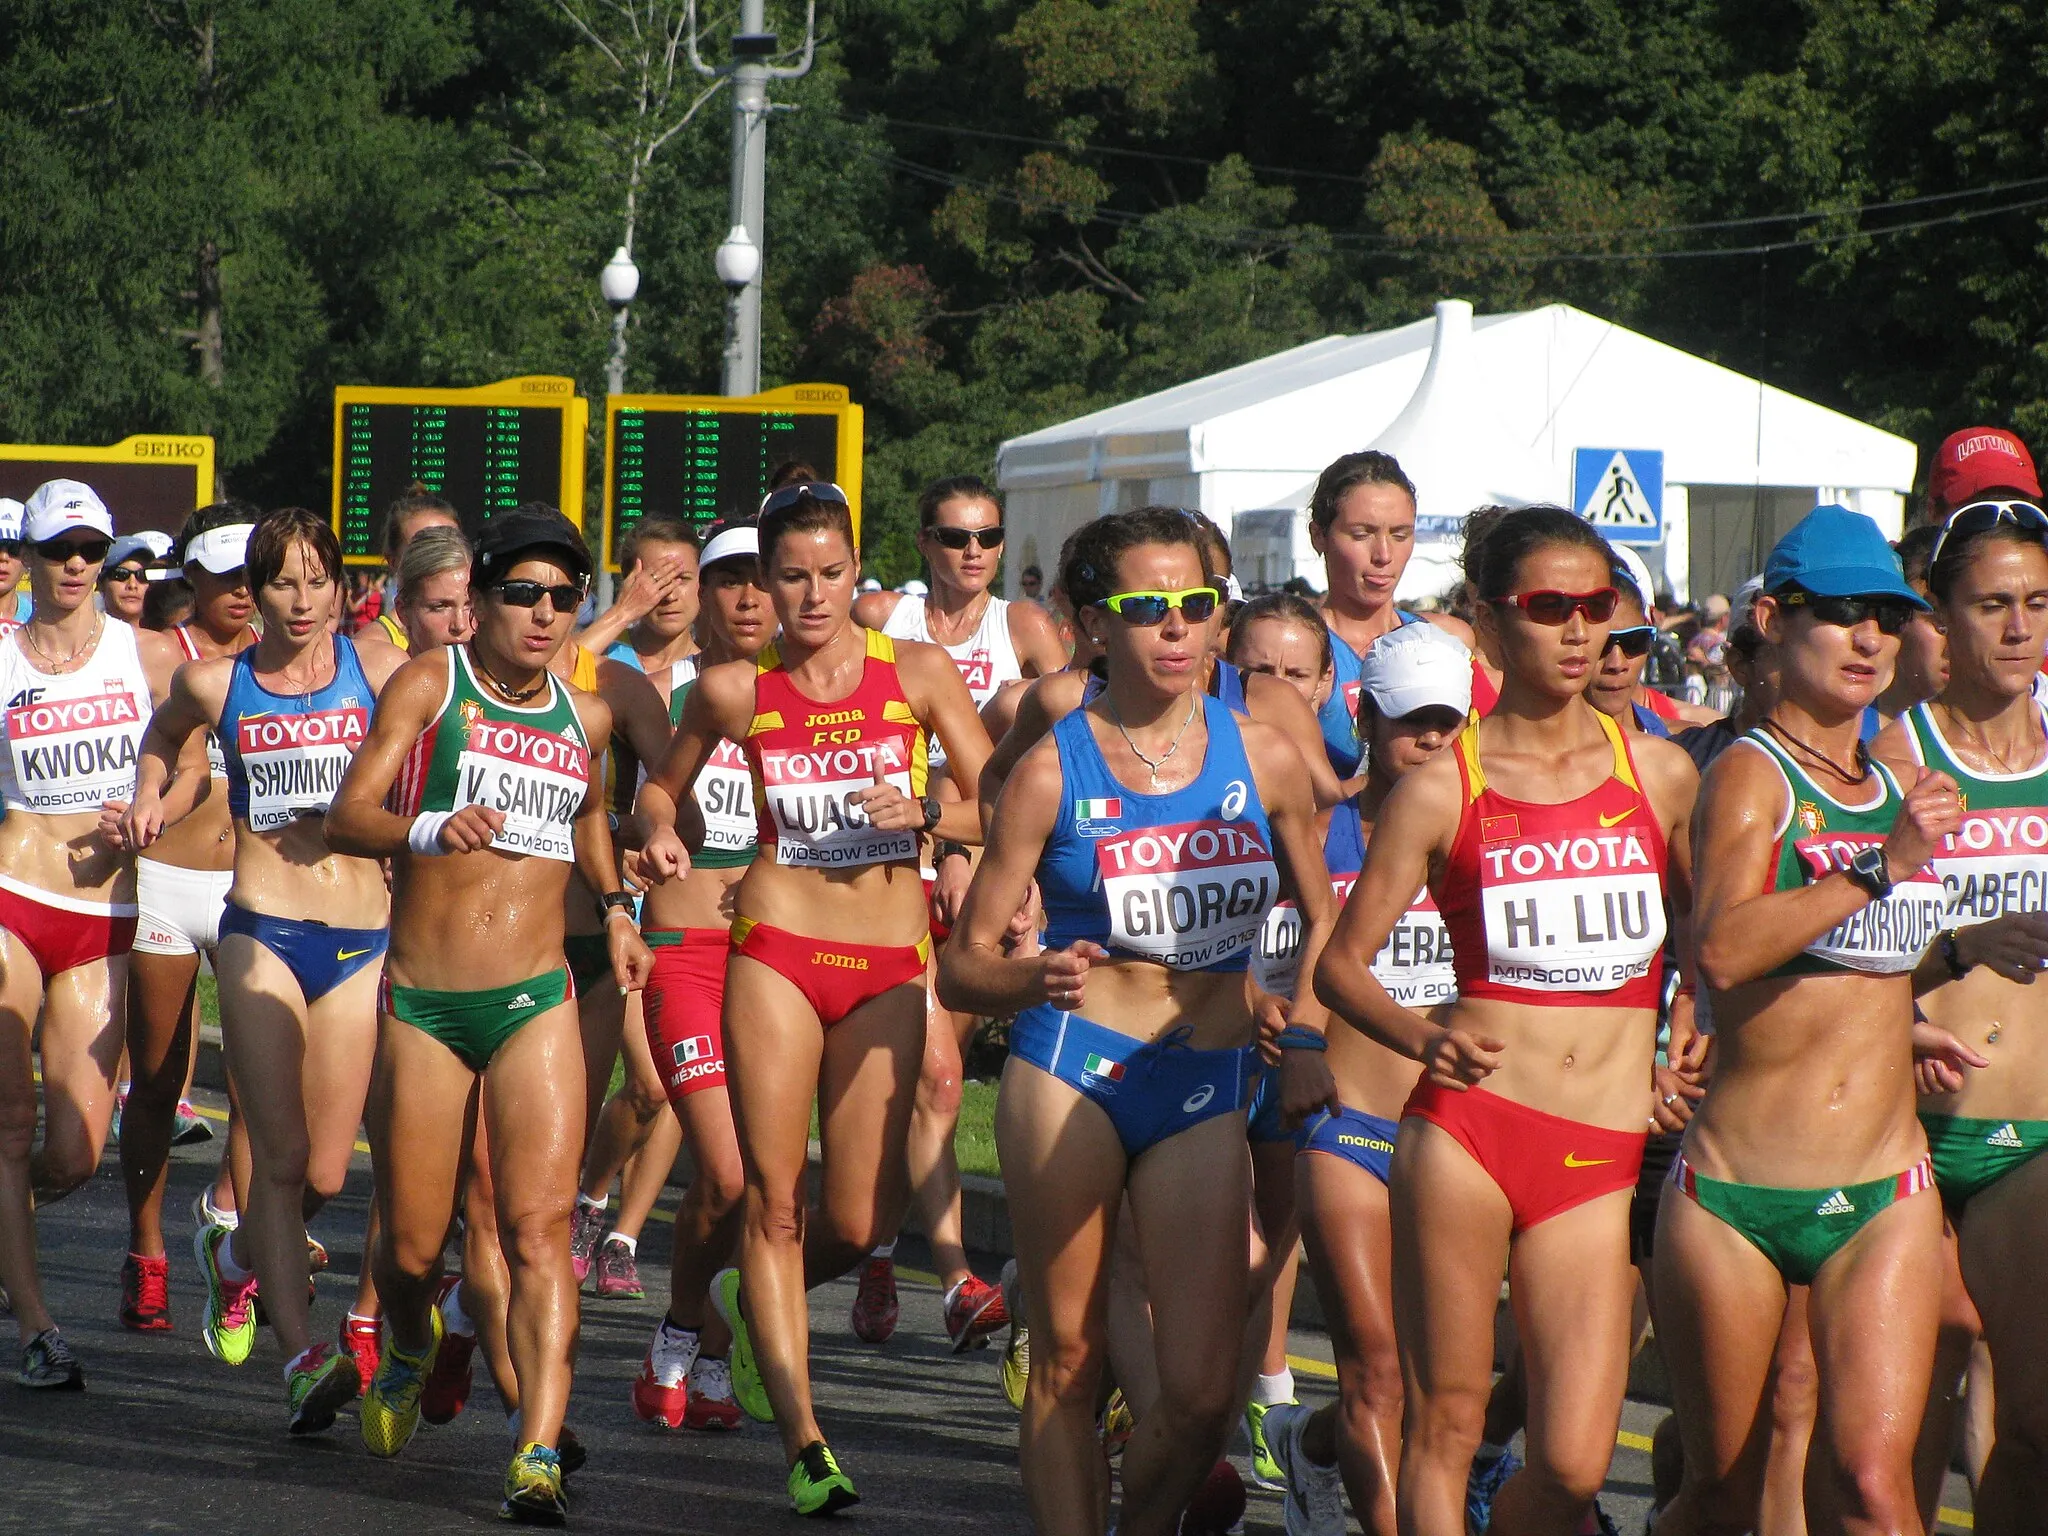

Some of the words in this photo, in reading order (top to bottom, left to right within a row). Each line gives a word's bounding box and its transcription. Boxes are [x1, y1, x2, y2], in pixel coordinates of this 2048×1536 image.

[521, 382, 568, 394] SEIKO
[794, 389, 843, 401] SEIKO
[134, 441, 205, 457] SEIKO
[1957, 434, 2020, 462] LATVIA
[12, 698, 135, 734] TOYOTA
[804, 709, 866, 728] Joma
[243, 714, 363, 748] TOYOTA
[812, 728, 862, 747] ESP
[21, 734, 137, 782] KWOKA
[476, 722, 584, 776] TOYOTA
[765, 743, 902, 781] TOYOTA
[26, 789, 101, 807] MOSCOW
[107, 780, 135, 799] 2013
[467, 764, 487, 806] V.
[495, 772, 580, 826] SANTOS
[534, 838, 569, 855] 2013
[781, 844, 863, 862] MOSCOW
[866, 839, 912, 858] 2013
[1104, 828, 1267, 870] TOYOTA
[1485, 835, 1650, 879] TOYOTA
[1122, 877, 1269, 937] GIORGI
[1504, 897, 1555, 949] H.
[1574, 890, 1651, 944] LIU
[810, 951, 869, 971] Joma
[1494, 964, 1604, 984] MOSCOW
[507, 1001, 536, 1010] adidas
[1338, 1133, 1395, 1154] marath
[1987, 1137, 2024, 1148] adidas
[1816, 1203, 1856, 1216] adidas
